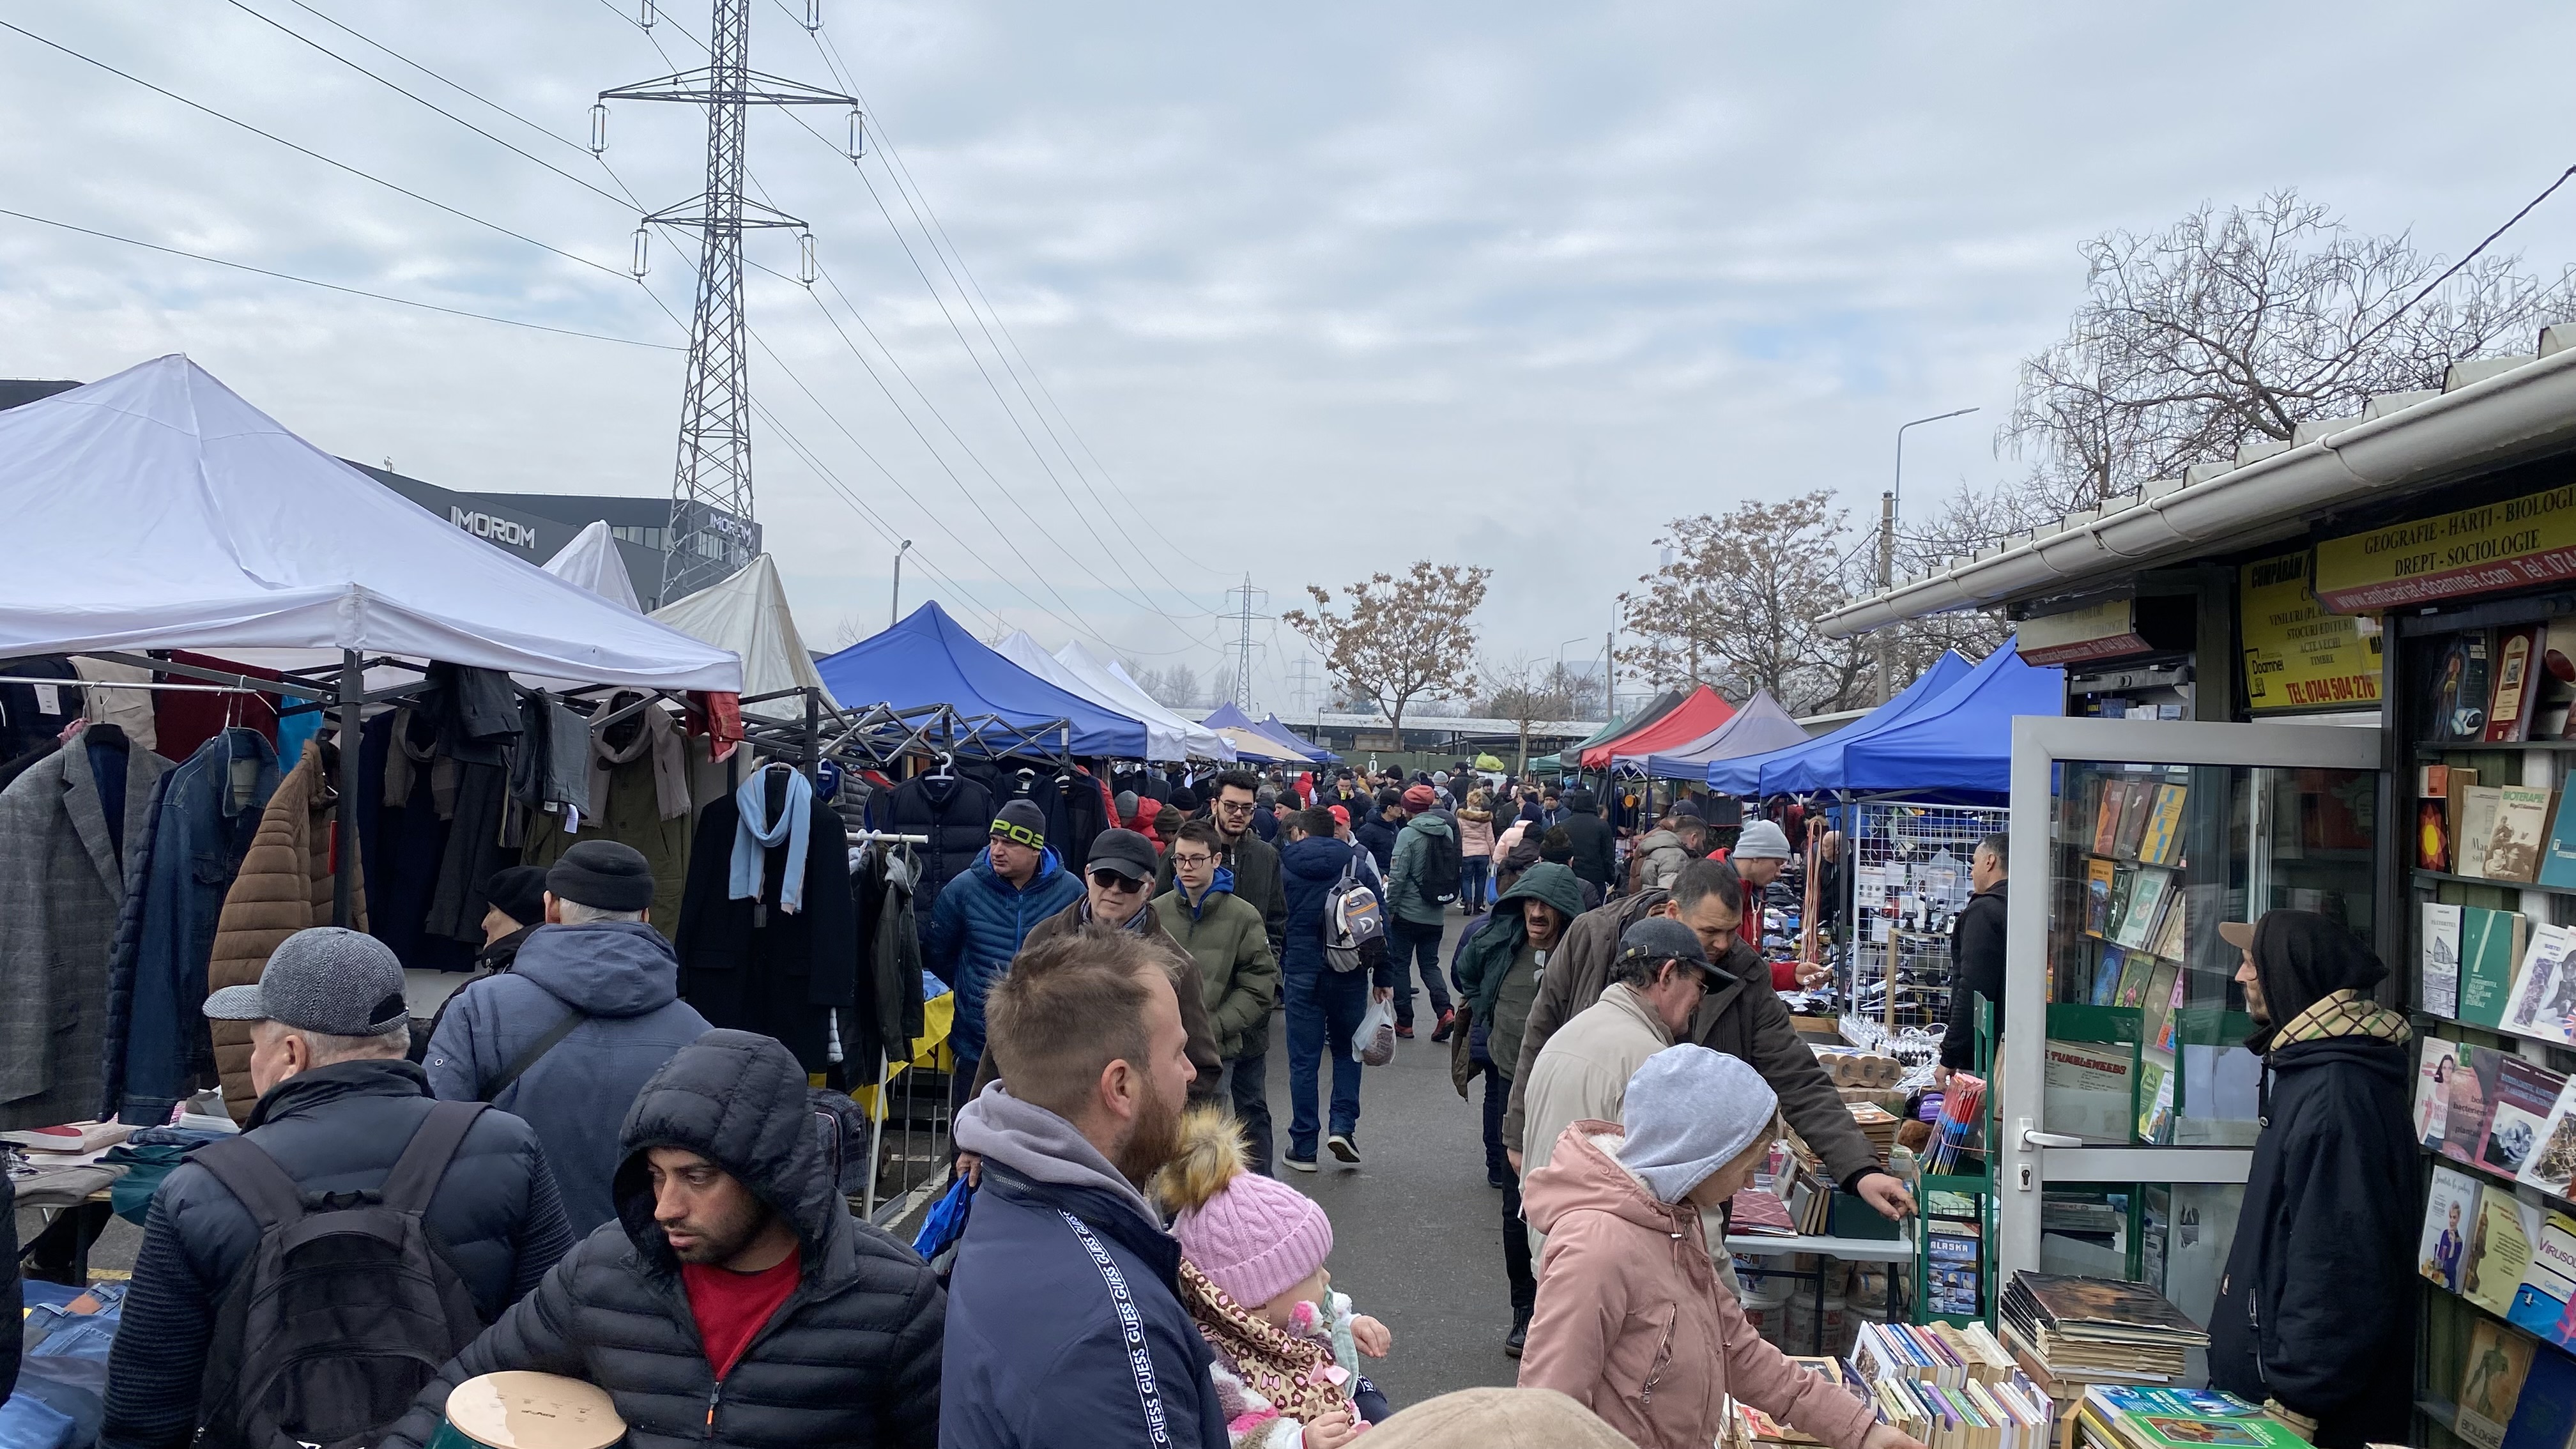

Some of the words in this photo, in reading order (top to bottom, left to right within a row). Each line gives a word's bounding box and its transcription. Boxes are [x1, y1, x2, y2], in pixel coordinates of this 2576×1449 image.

[450, 505, 535, 549] IMOROM
[709, 512, 753, 540] IMOROM
[2365, 521, 2438, 555] GEOGRAFIE
[2505, 486, 2576, 522] BIOLOGI
[2395, 552, 2437, 577] DREPT
[2447, 528, 2542, 567] SOCIOLOGIE
[2336, 567, 2518, 608] www.anticariat-doamnei.com
[2511, 557, 2552, 579] Tel:
[2287, 625, 2319, 640] STOCURI
[2310, 654, 2334, 666] TIMBRE
[2286, 682, 2306, 705] TEL:
[2304, 678, 2332, 703] 0744
[2332, 675, 2354, 700] 504
[2353, 675, 2376, 698] 276
[2503, 790, 2546, 804] BIOTERAPIE
[1083, 1236, 1110, 1264] GUESS
[1929, 1241, 1969, 1254] ALASKA
[1103, 1266, 1128, 1300] GUESS
[1119, 1301, 1141, 1343] GUESS
[1131, 1348, 1154, 1394] GUESS
[1146, 1398, 1167, 1443] GUESS
[2461, 1418, 2500, 1448] BIOLOGIE
